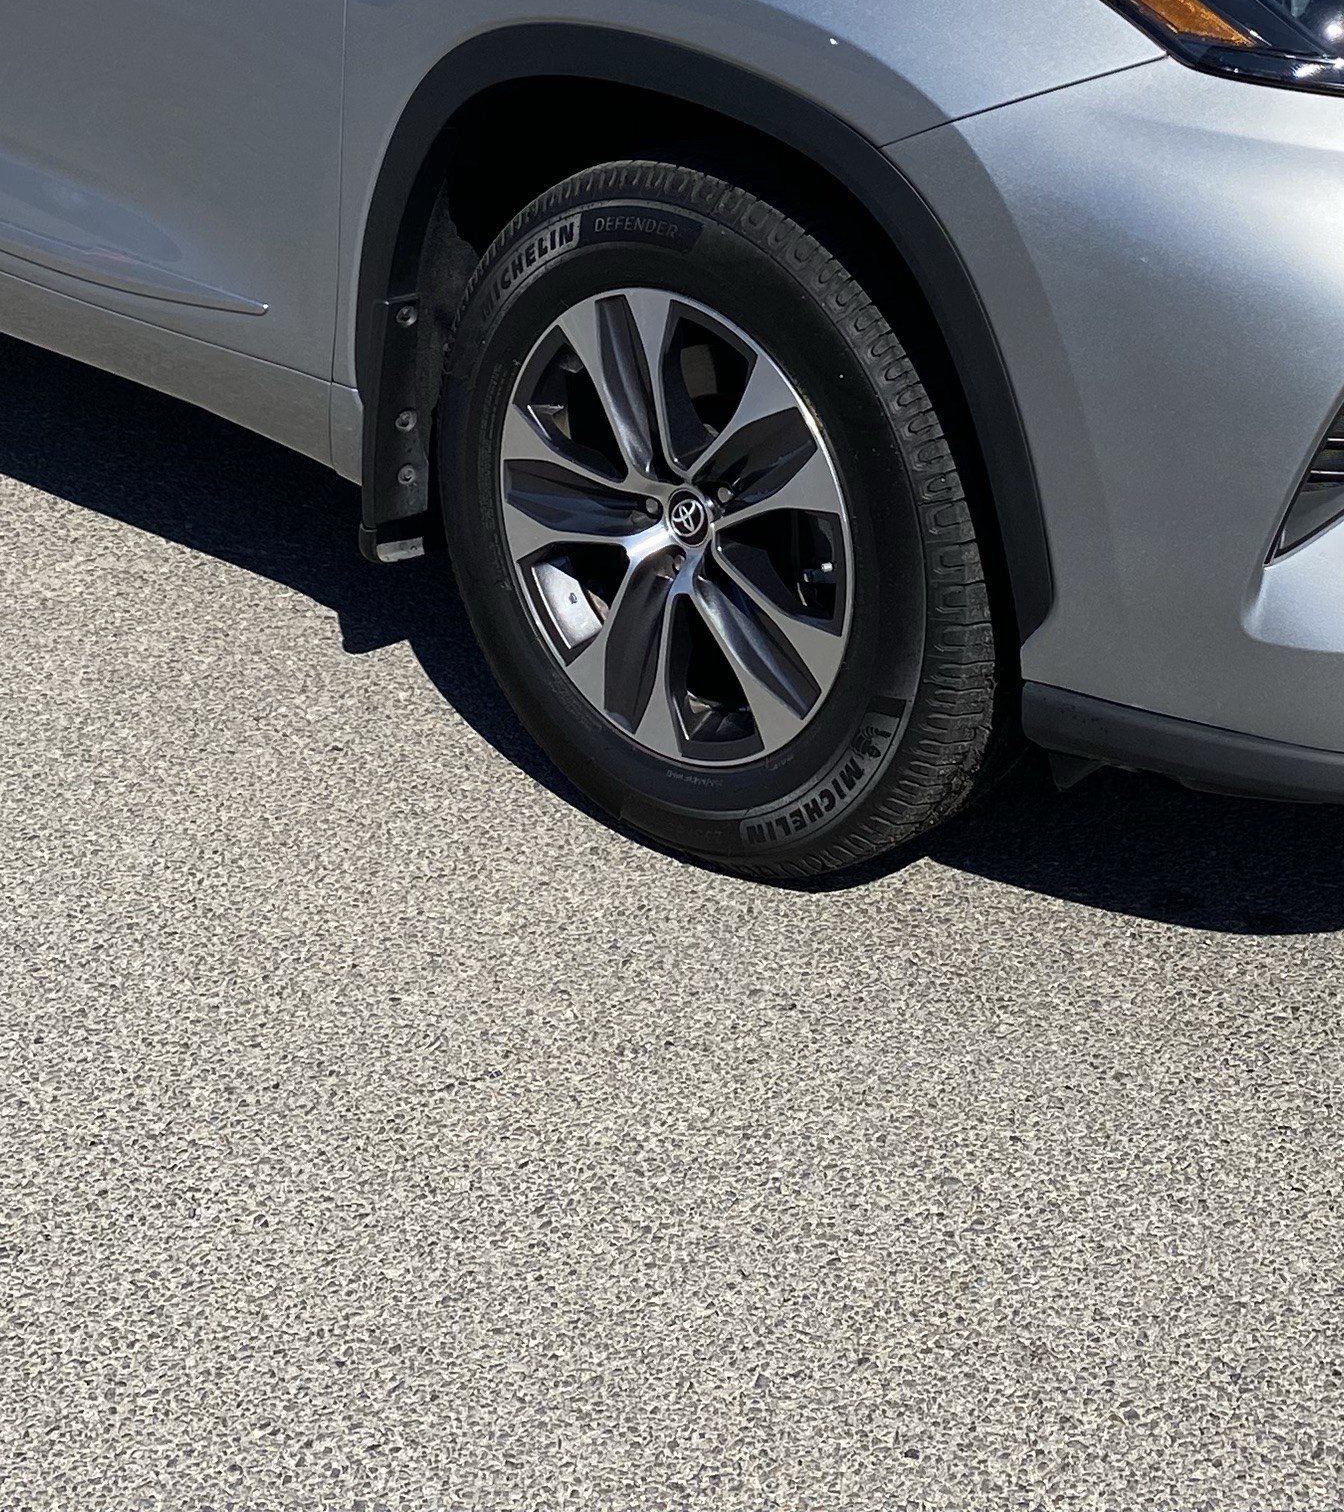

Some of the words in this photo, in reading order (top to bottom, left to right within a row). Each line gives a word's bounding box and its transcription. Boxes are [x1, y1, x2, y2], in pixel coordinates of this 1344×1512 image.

[482, 220, 576, 322] MICHELIN
[594, 216, 679, 238] DEFENDER
[746, 756, 865, 845] MICHELIN
